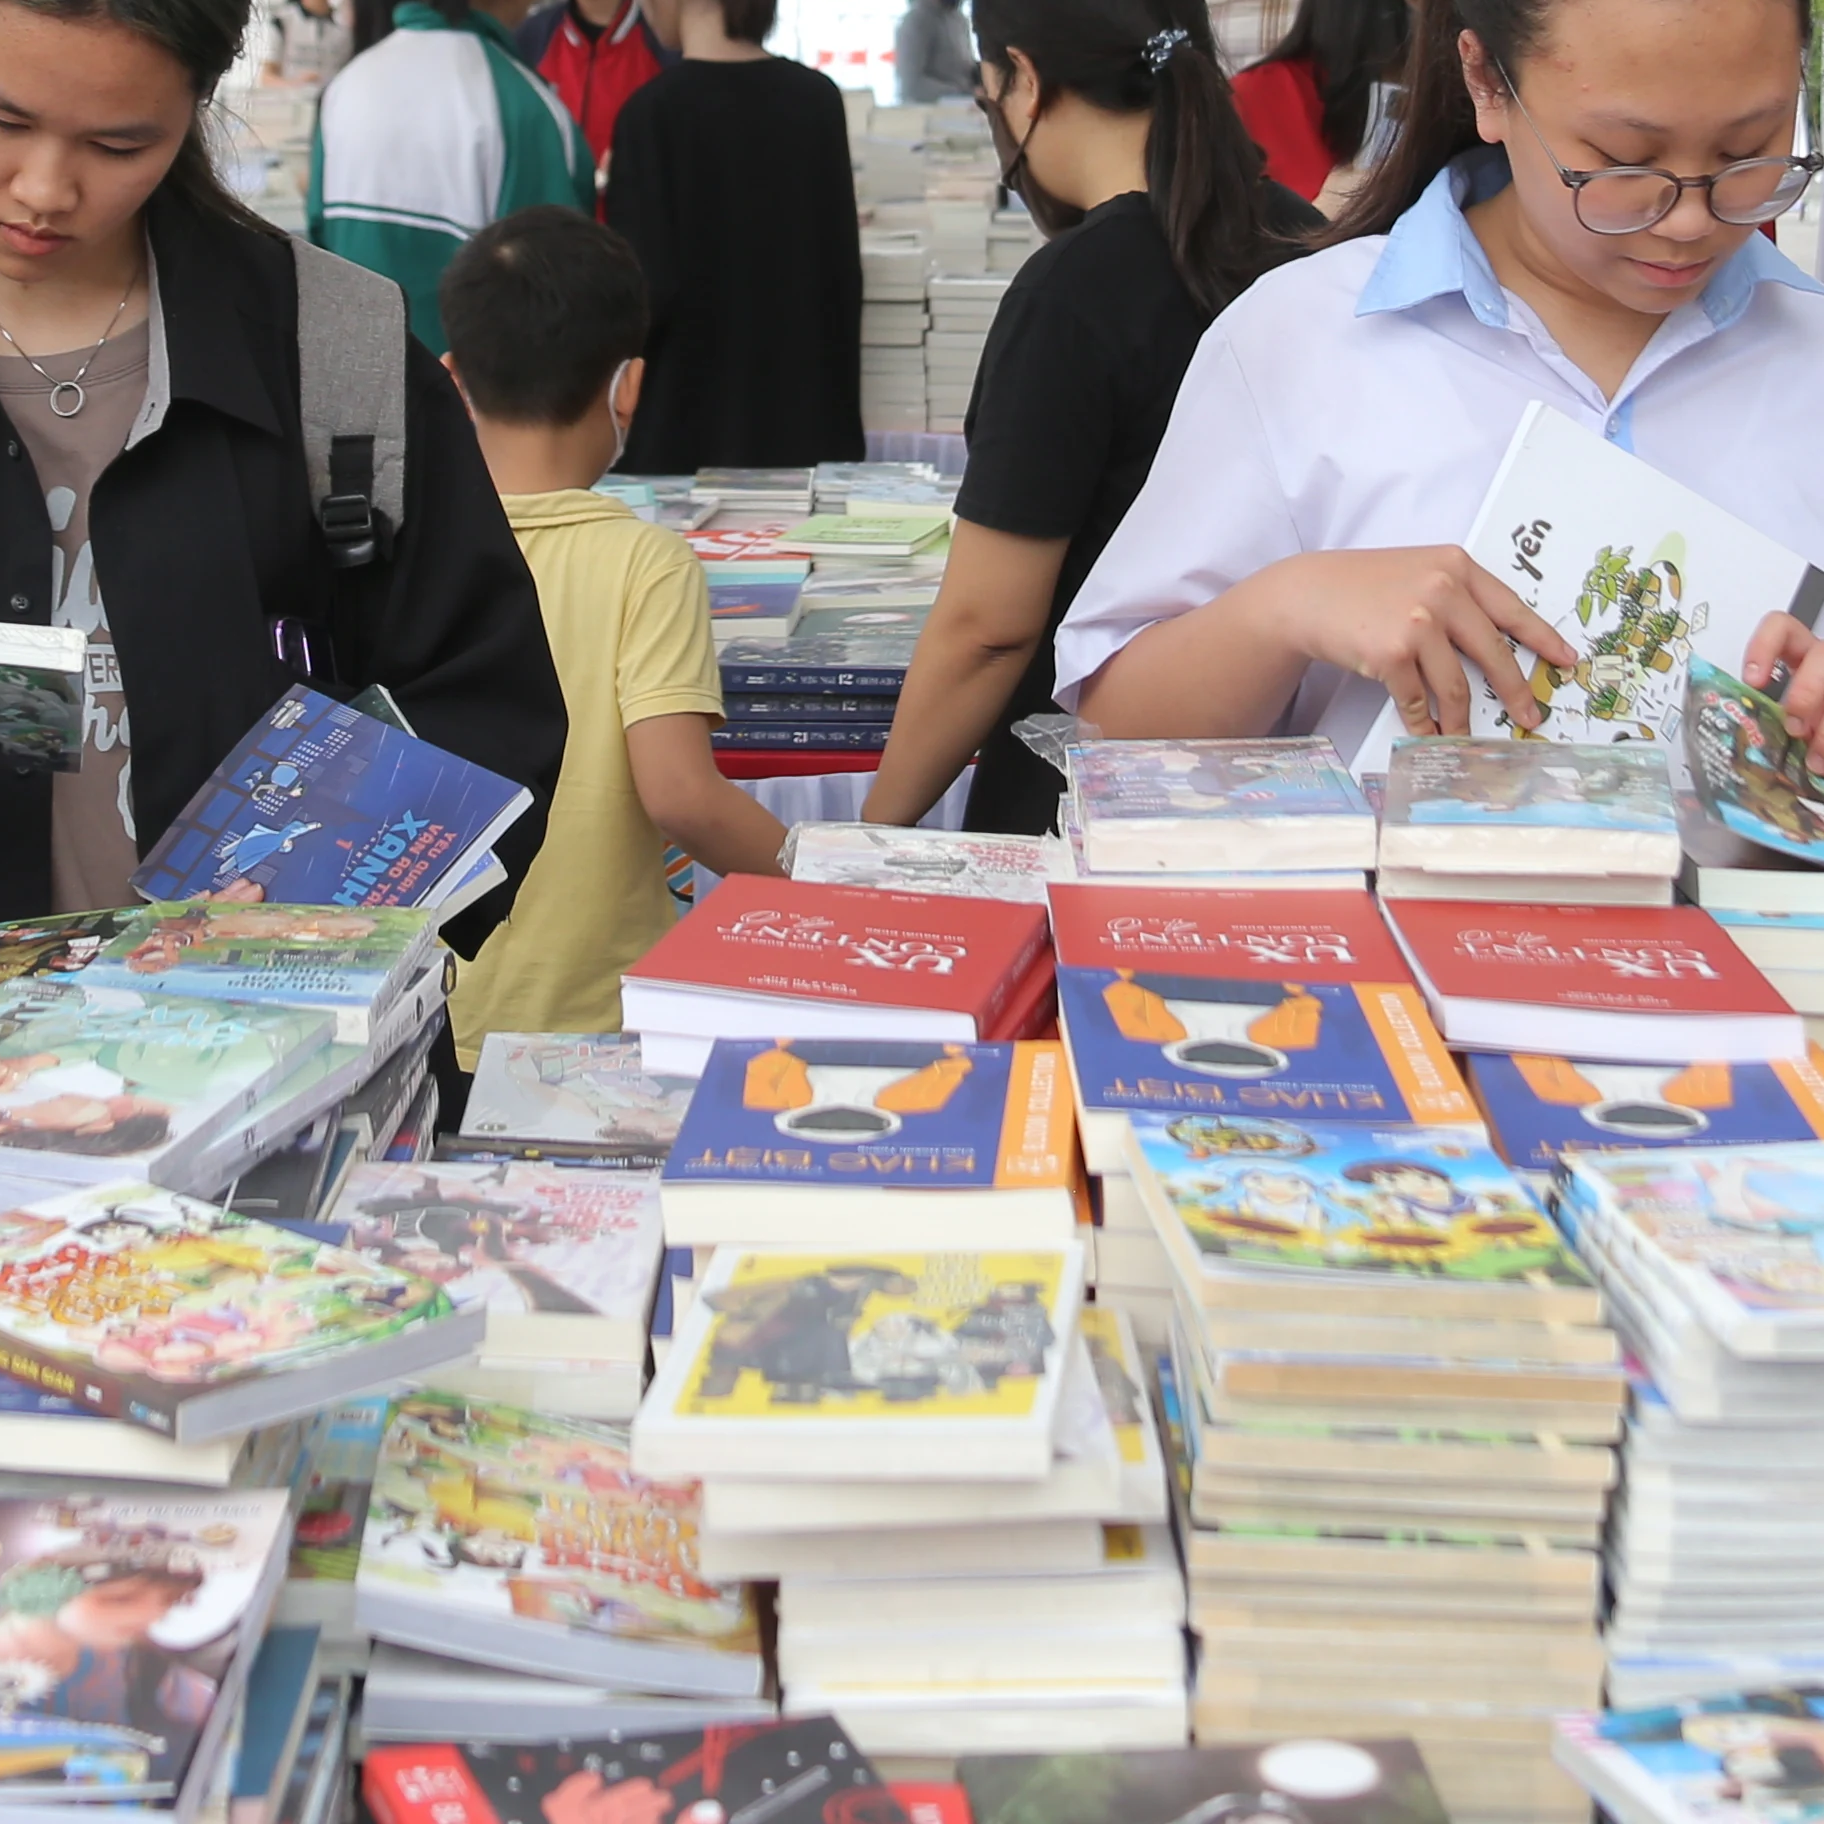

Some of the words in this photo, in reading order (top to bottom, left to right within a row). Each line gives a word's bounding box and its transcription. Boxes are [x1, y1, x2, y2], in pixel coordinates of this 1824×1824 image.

[330, 809, 430, 910] XANH
[714, 919, 966, 959] CONTENT
[1241, 942, 1358, 966] UX
[843, 946, 952, 976] UX
